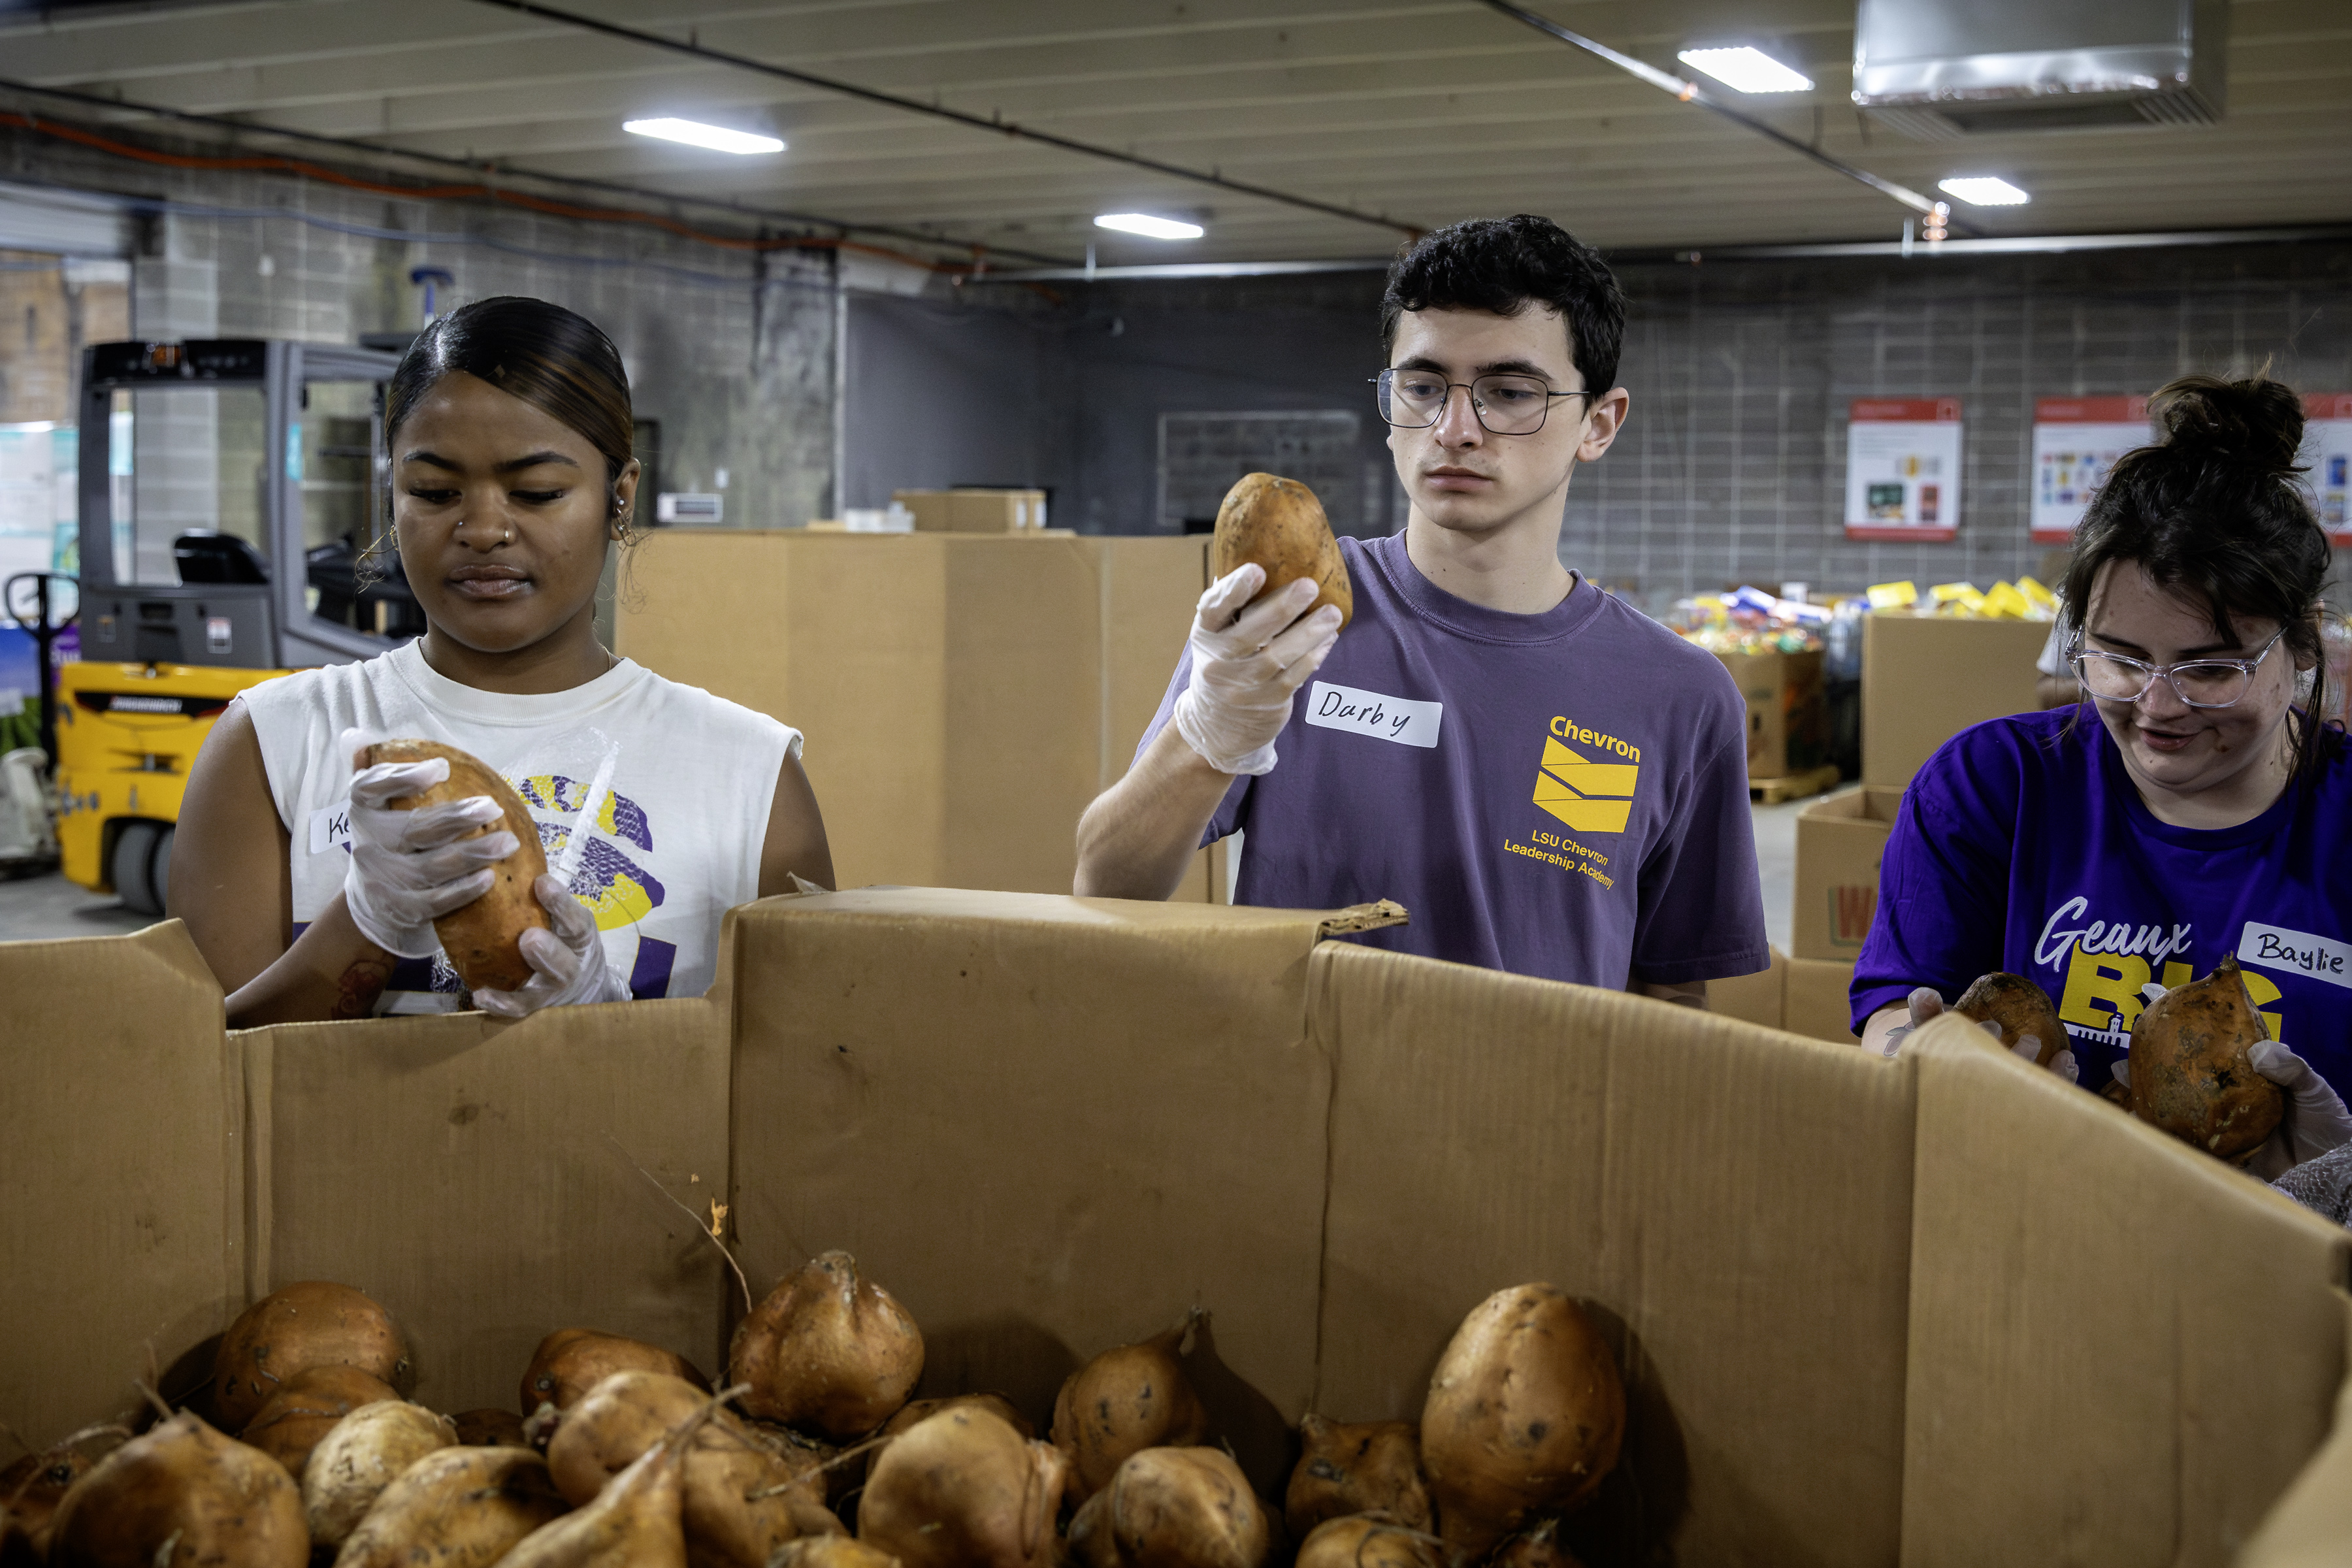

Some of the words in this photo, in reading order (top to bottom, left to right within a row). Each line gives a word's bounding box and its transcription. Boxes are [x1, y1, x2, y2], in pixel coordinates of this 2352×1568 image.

[1318, 691, 1411, 737] Darby
[1550, 715, 1641, 763] Chevron
[1503, 838, 1575, 871] Leadership
[1577, 861, 1614, 890] Academy
[1531, 829, 1560, 847] LSU
[1561, 839, 1609, 866] Chevron
[2034, 896, 2192, 973] Geaux
[2257, 933, 2344, 975] Baylie
